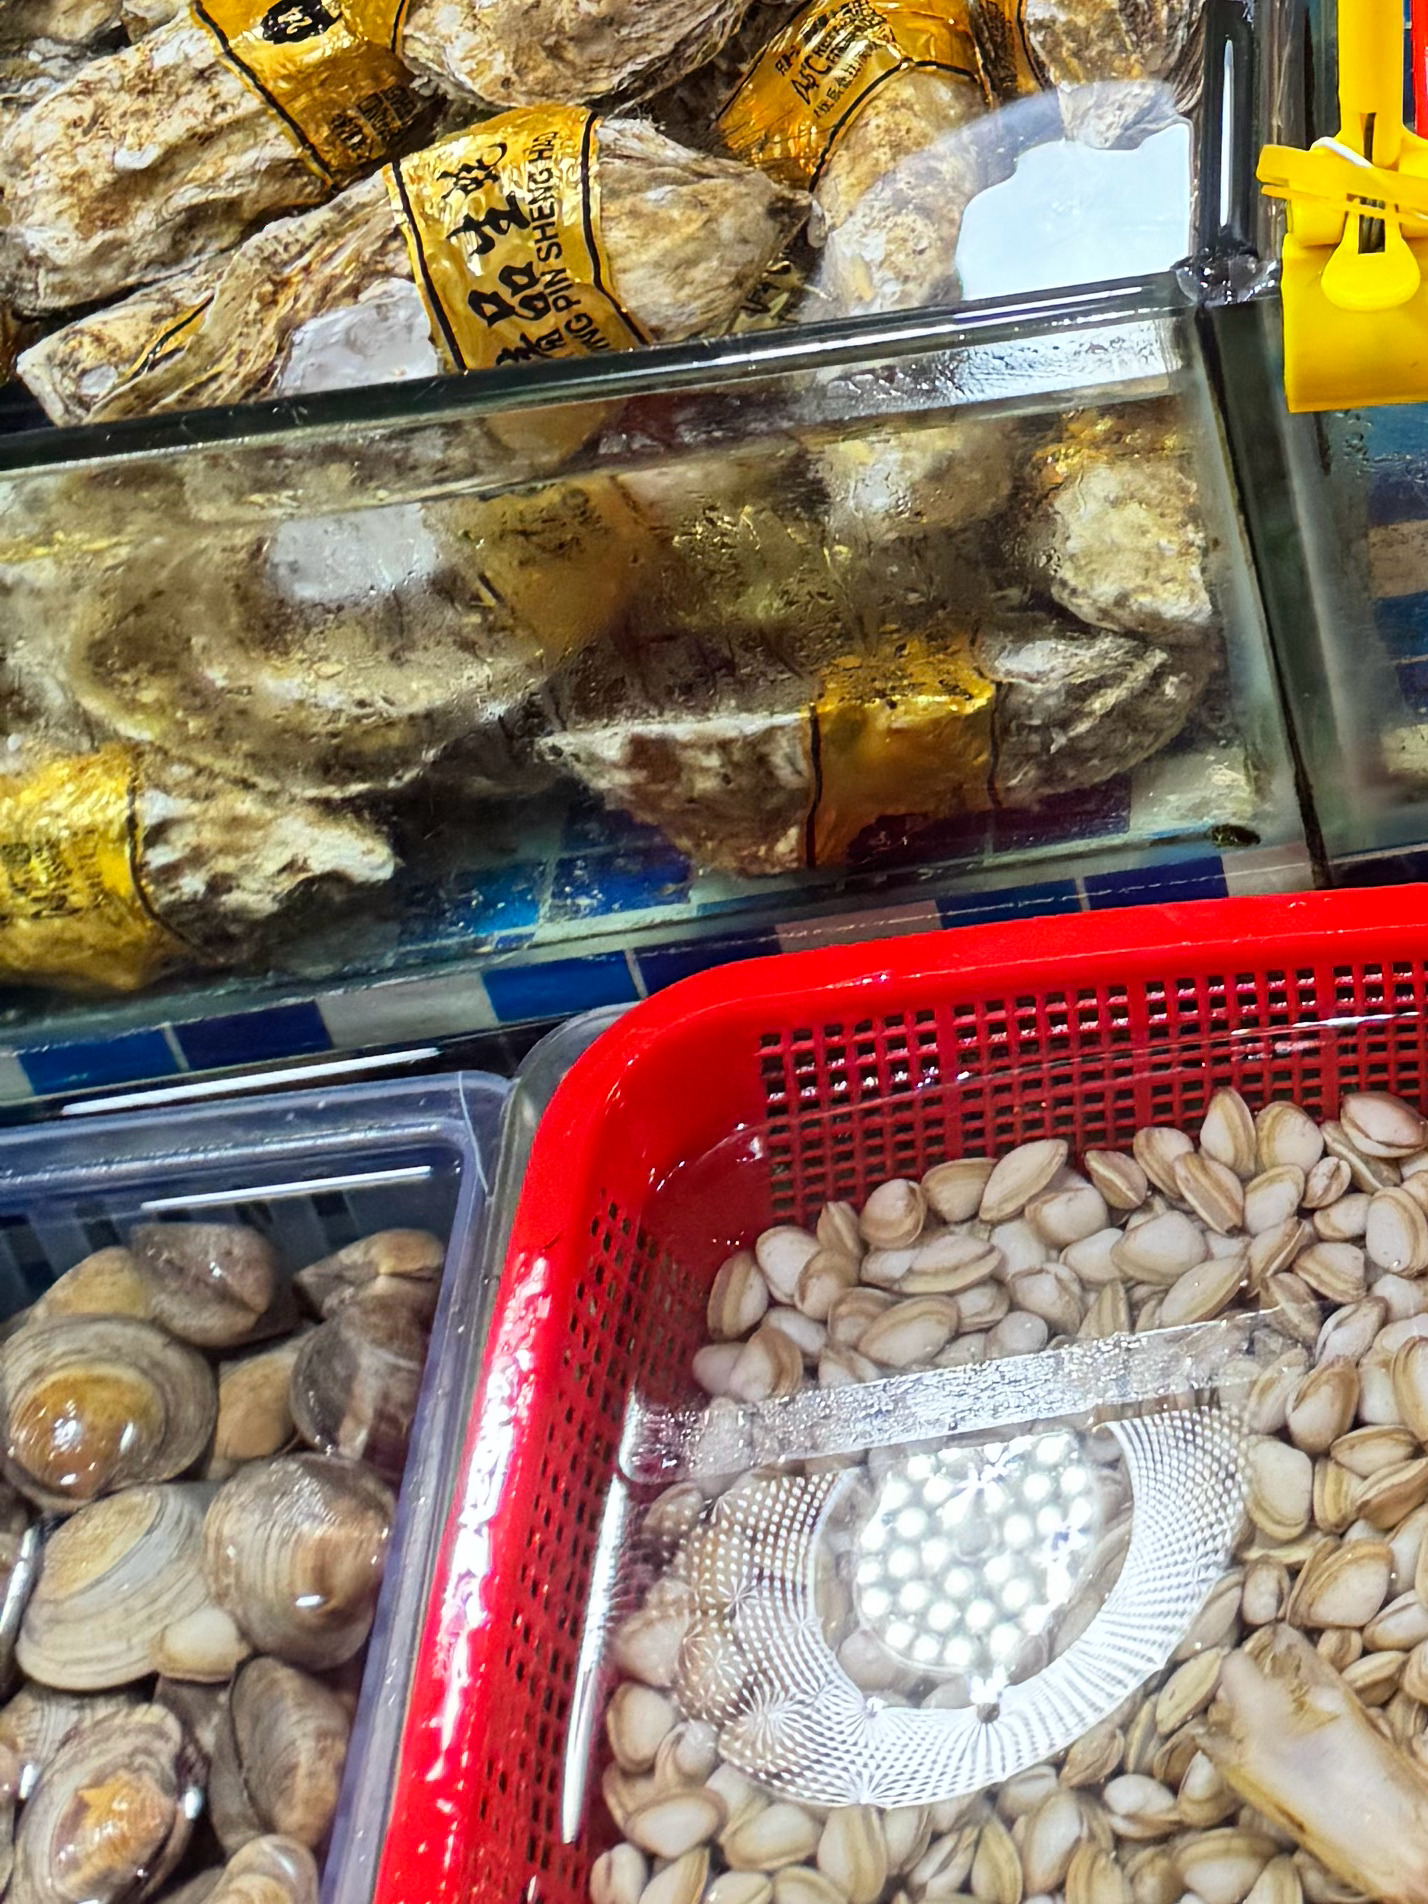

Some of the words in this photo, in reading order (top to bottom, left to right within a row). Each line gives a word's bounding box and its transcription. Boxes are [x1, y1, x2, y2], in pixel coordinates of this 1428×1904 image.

[528, 168, 563, 263] SHENG
[541, 268, 581, 313] PIN
[564, 314, 610, 350] ING
